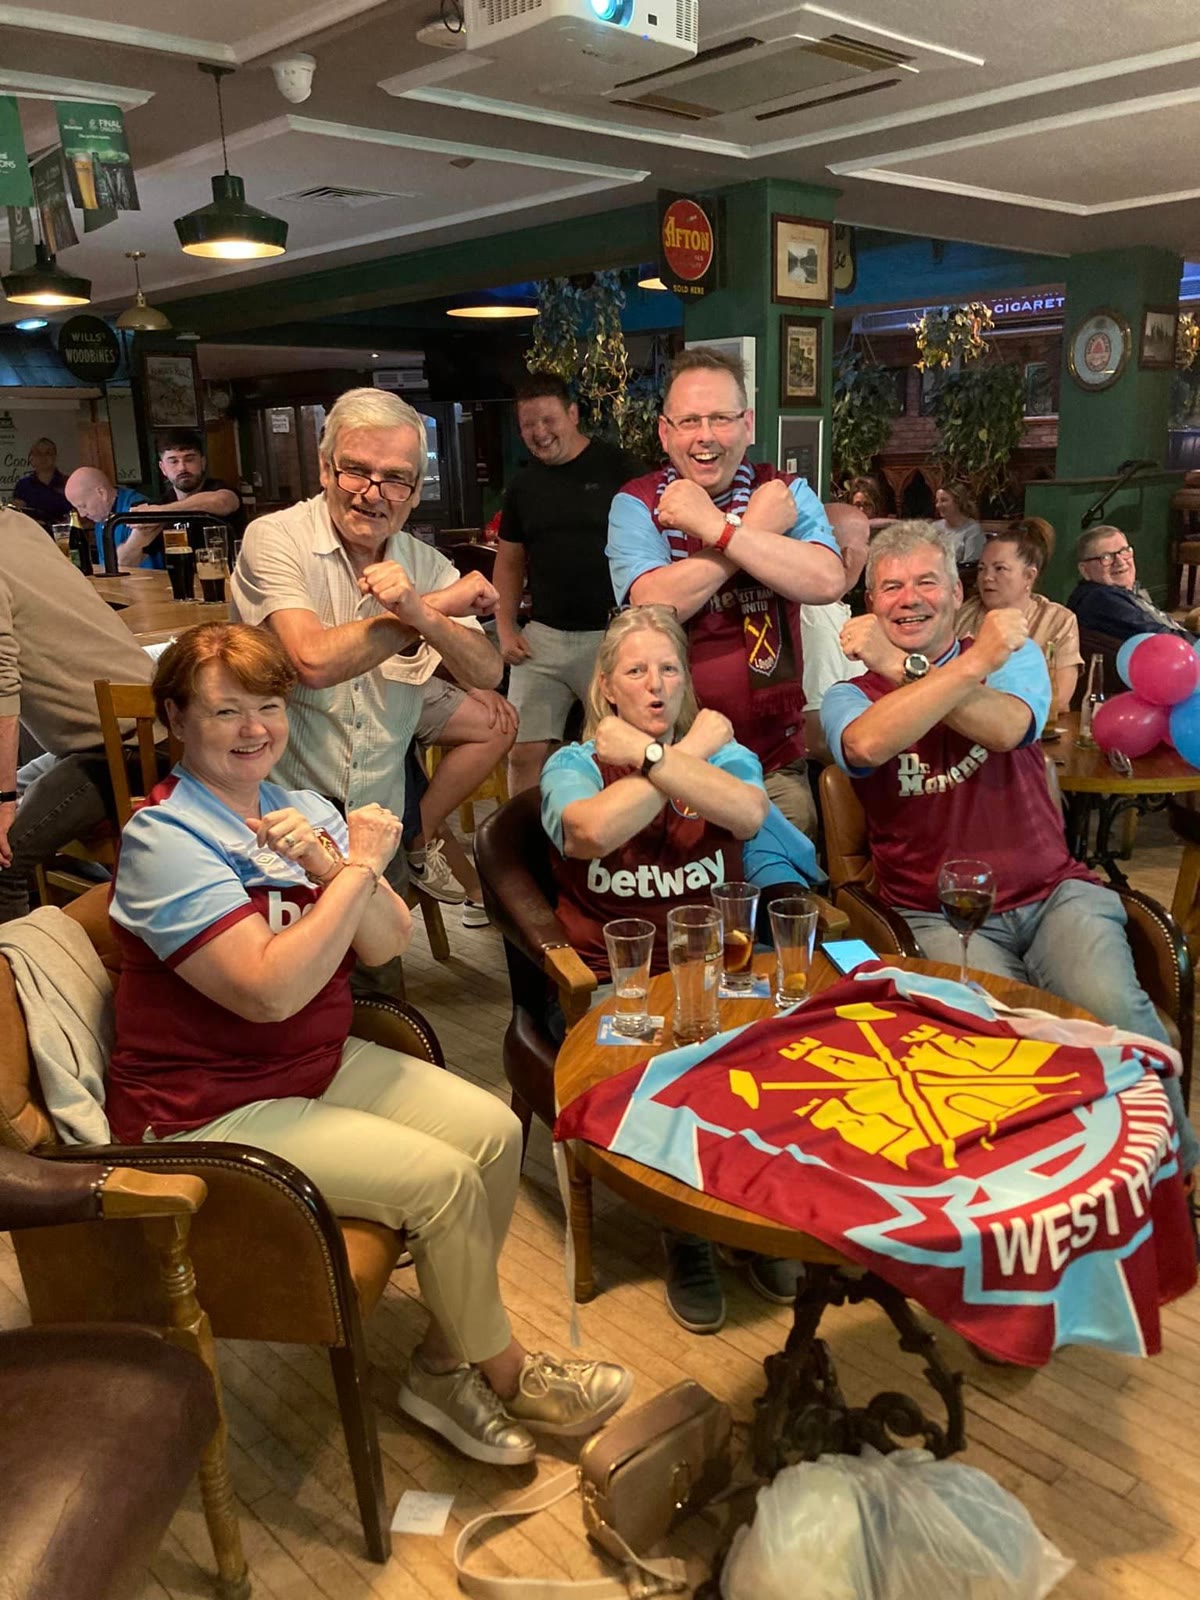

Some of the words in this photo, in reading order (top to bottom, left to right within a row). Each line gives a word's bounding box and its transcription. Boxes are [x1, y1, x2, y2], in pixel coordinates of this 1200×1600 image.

[664, 216, 709, 252] AFTON
[672, 284, 688, 294] SOLD
[690, 286, 705, 295] HERE
[994, 297, 1066, 313] CIGARET
[4, 453, 31, 467] Coo
[898, 752, 931, 775] Dr.
[587, 849, 725, 898] betway
[988, 1177, 1120, 1276] WEST
